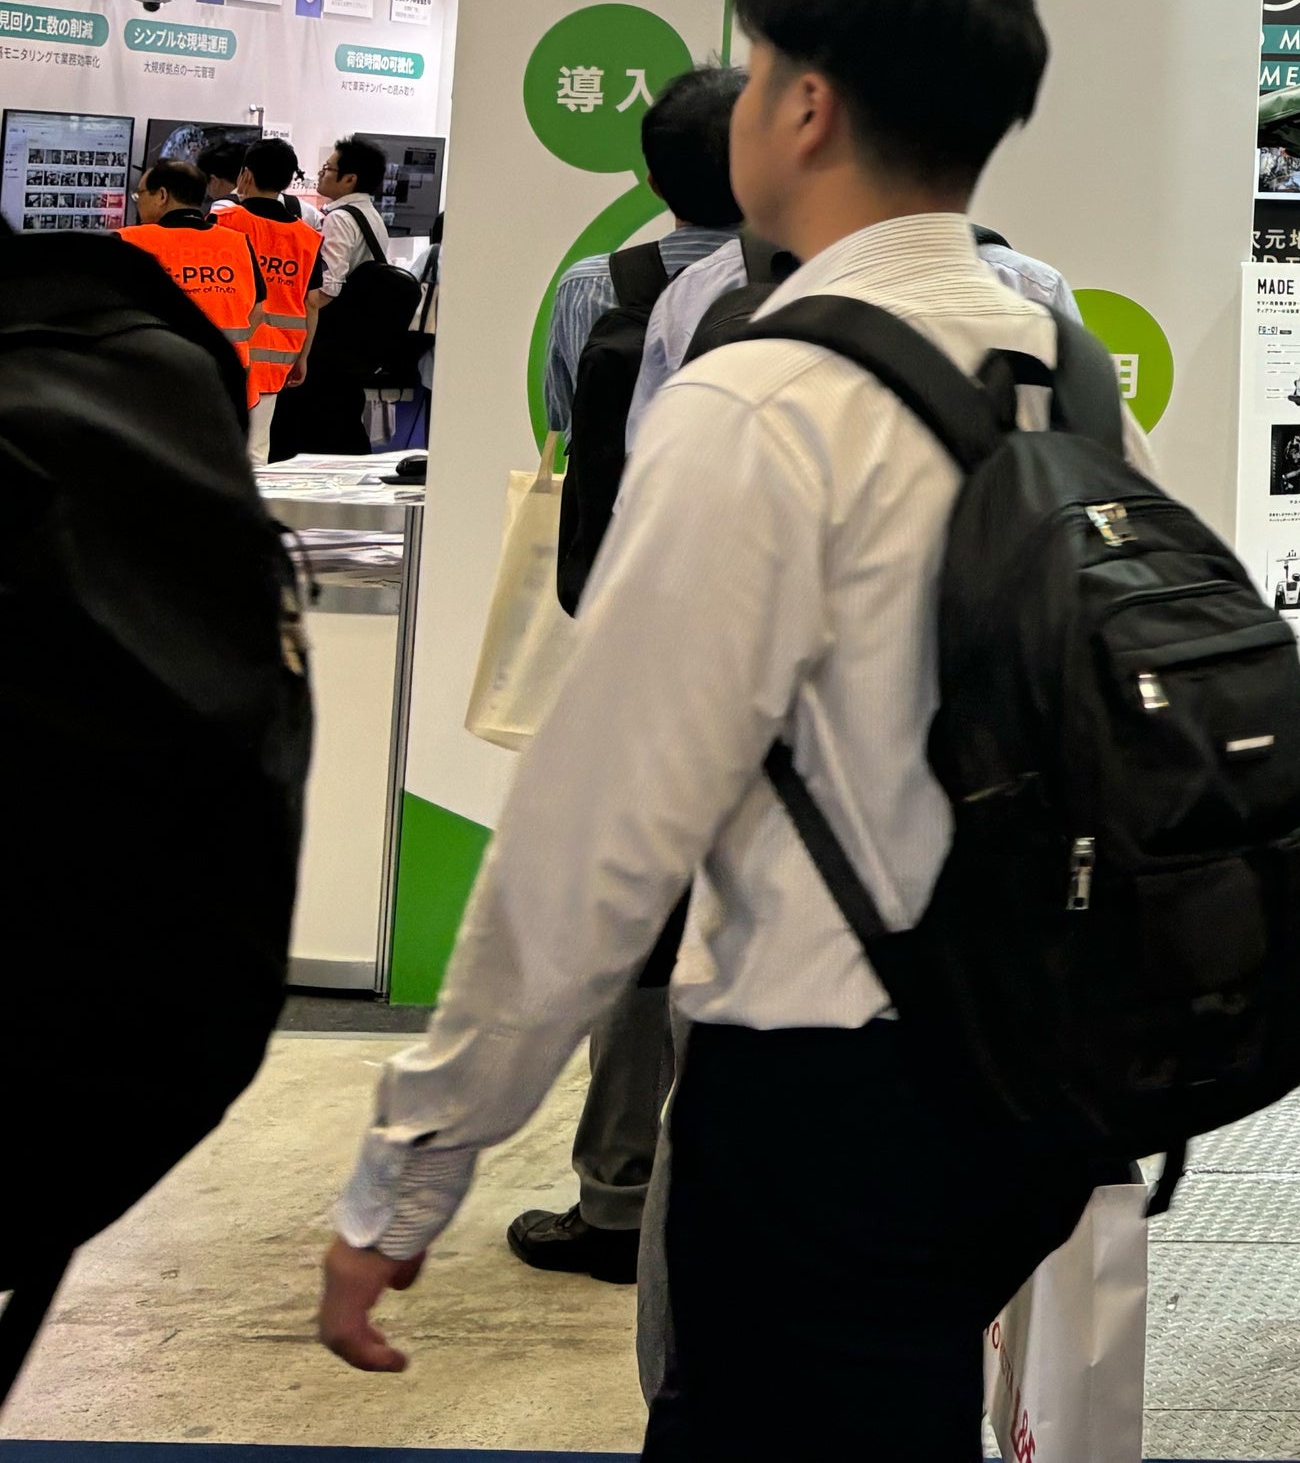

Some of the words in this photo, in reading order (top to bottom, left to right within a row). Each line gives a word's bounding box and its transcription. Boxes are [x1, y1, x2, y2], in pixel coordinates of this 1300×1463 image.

[0, 45, 101, 70] モニタリングで業務効率化
[1258, 278, 1294, 296] MADE
